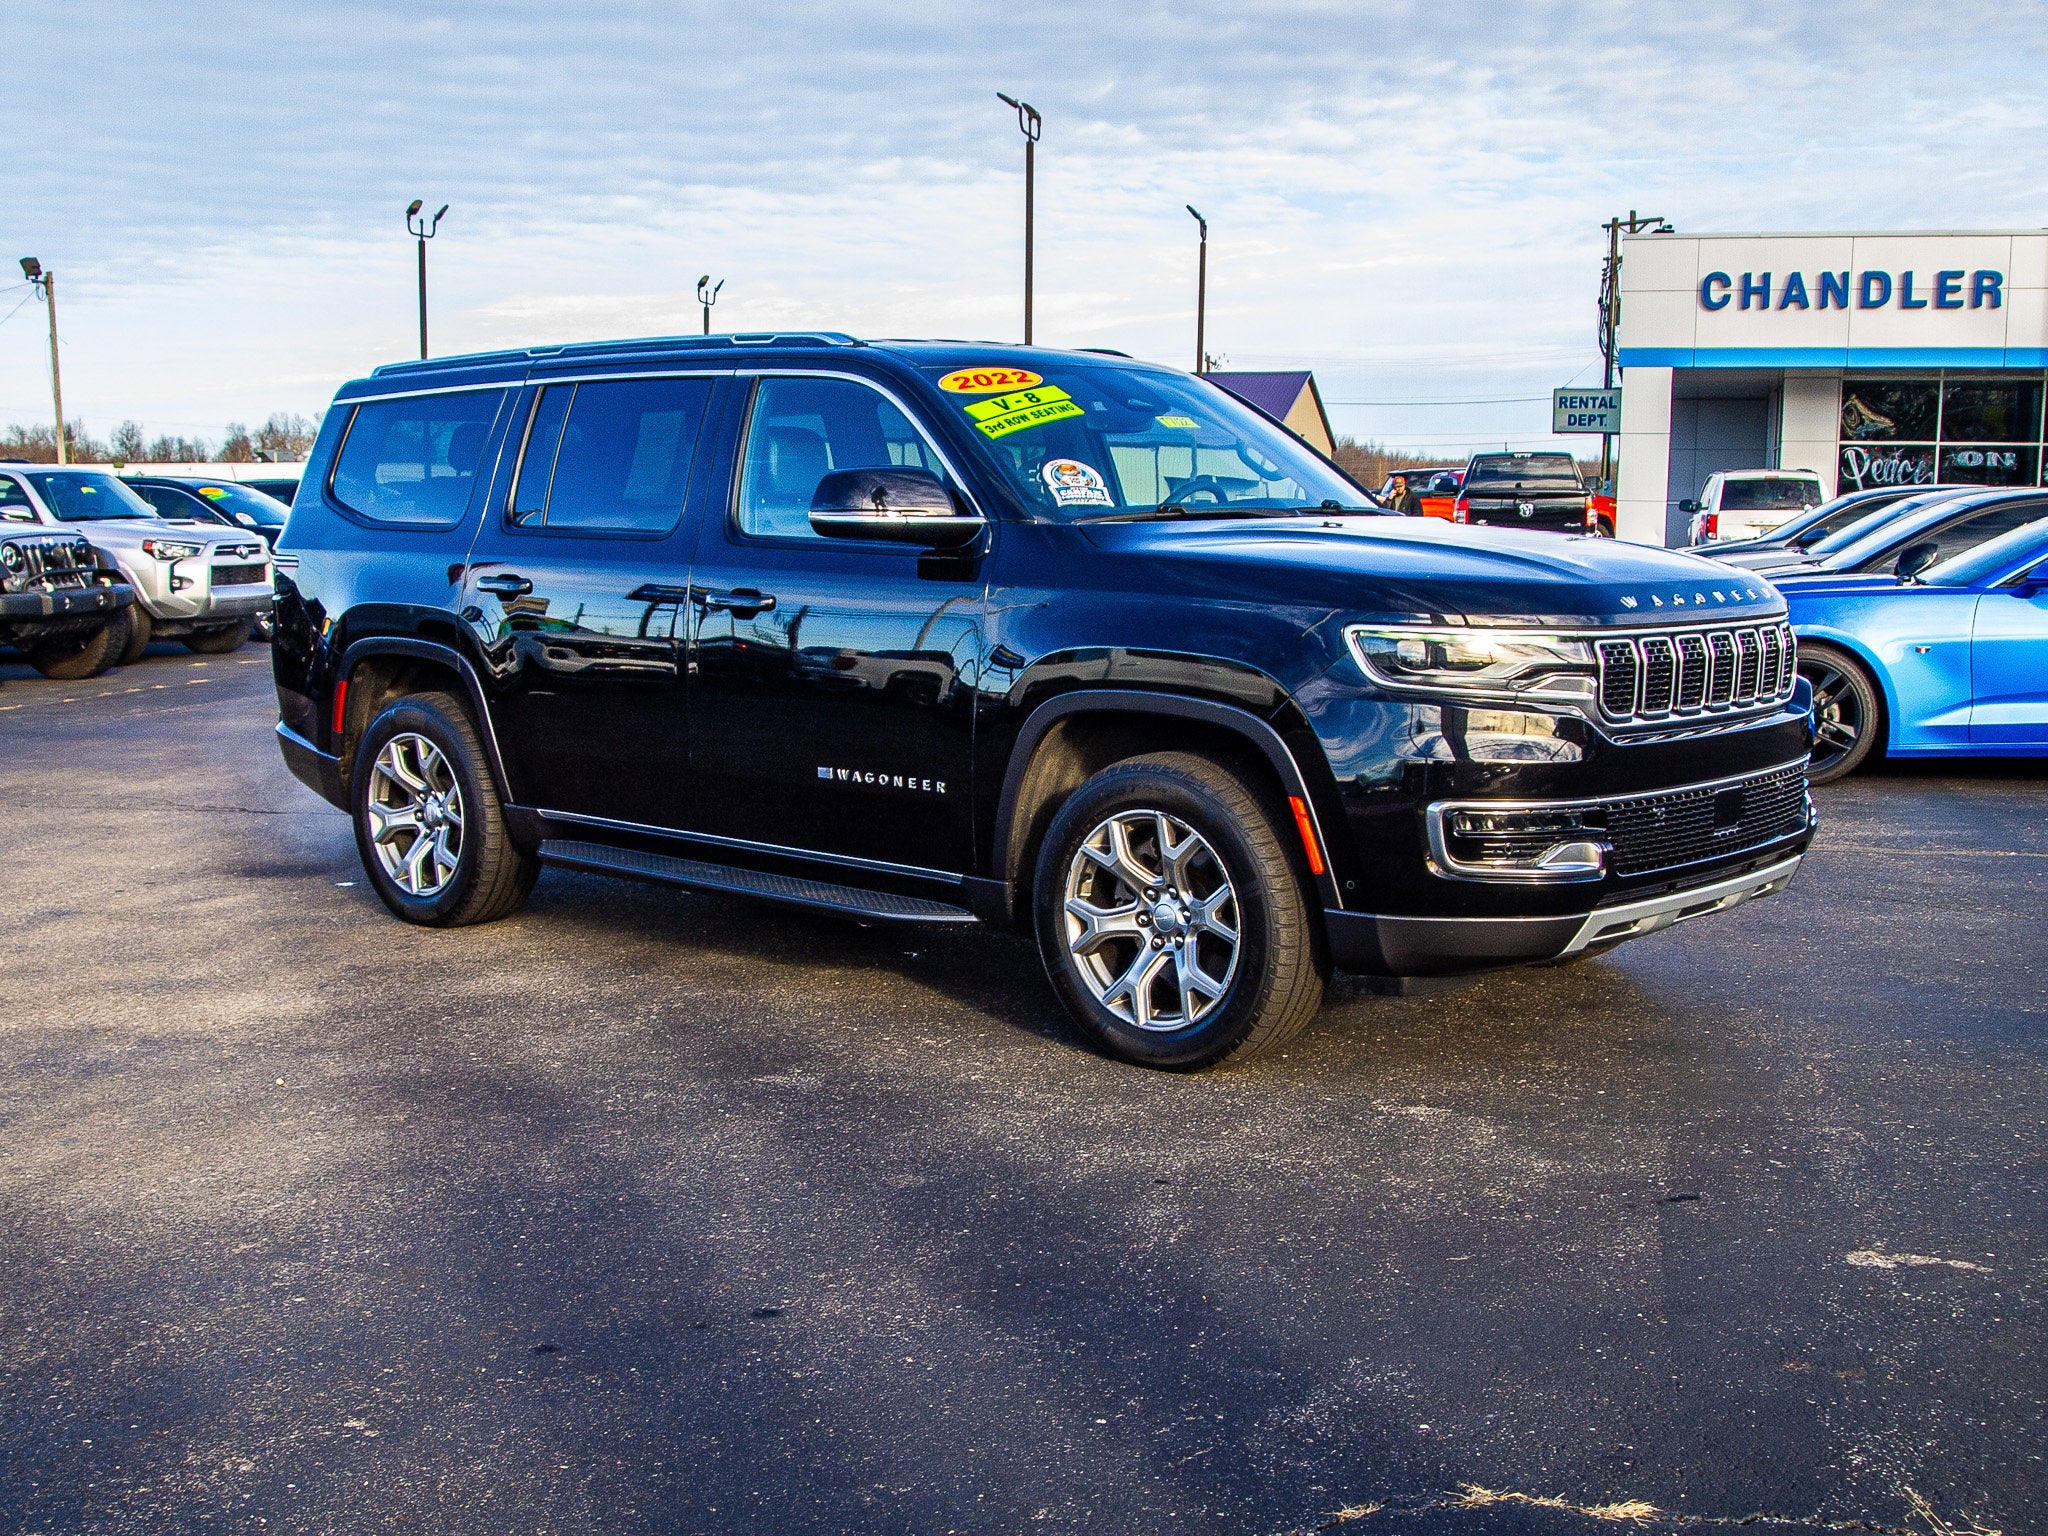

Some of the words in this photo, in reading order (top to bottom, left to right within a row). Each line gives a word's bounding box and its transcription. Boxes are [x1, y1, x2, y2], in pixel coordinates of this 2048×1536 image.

[1700, 270, 2004, 311] CHANDLER
[953, 371, 1033, 390] 2022
[1558, 396, 1617, 409] RENTAL
[985, 421, 1004, 434] 3rd
[1005, 413, 1030, 427] ROW
[1031, 404, 1075, 420] SEATING
[1567, 414, 1607, 426] DEPT.
[1842, 446, 1934, 490] Peace
[1956, 451, 2016, 469] ON
[836, 768, 946, 794] WAGONEER
